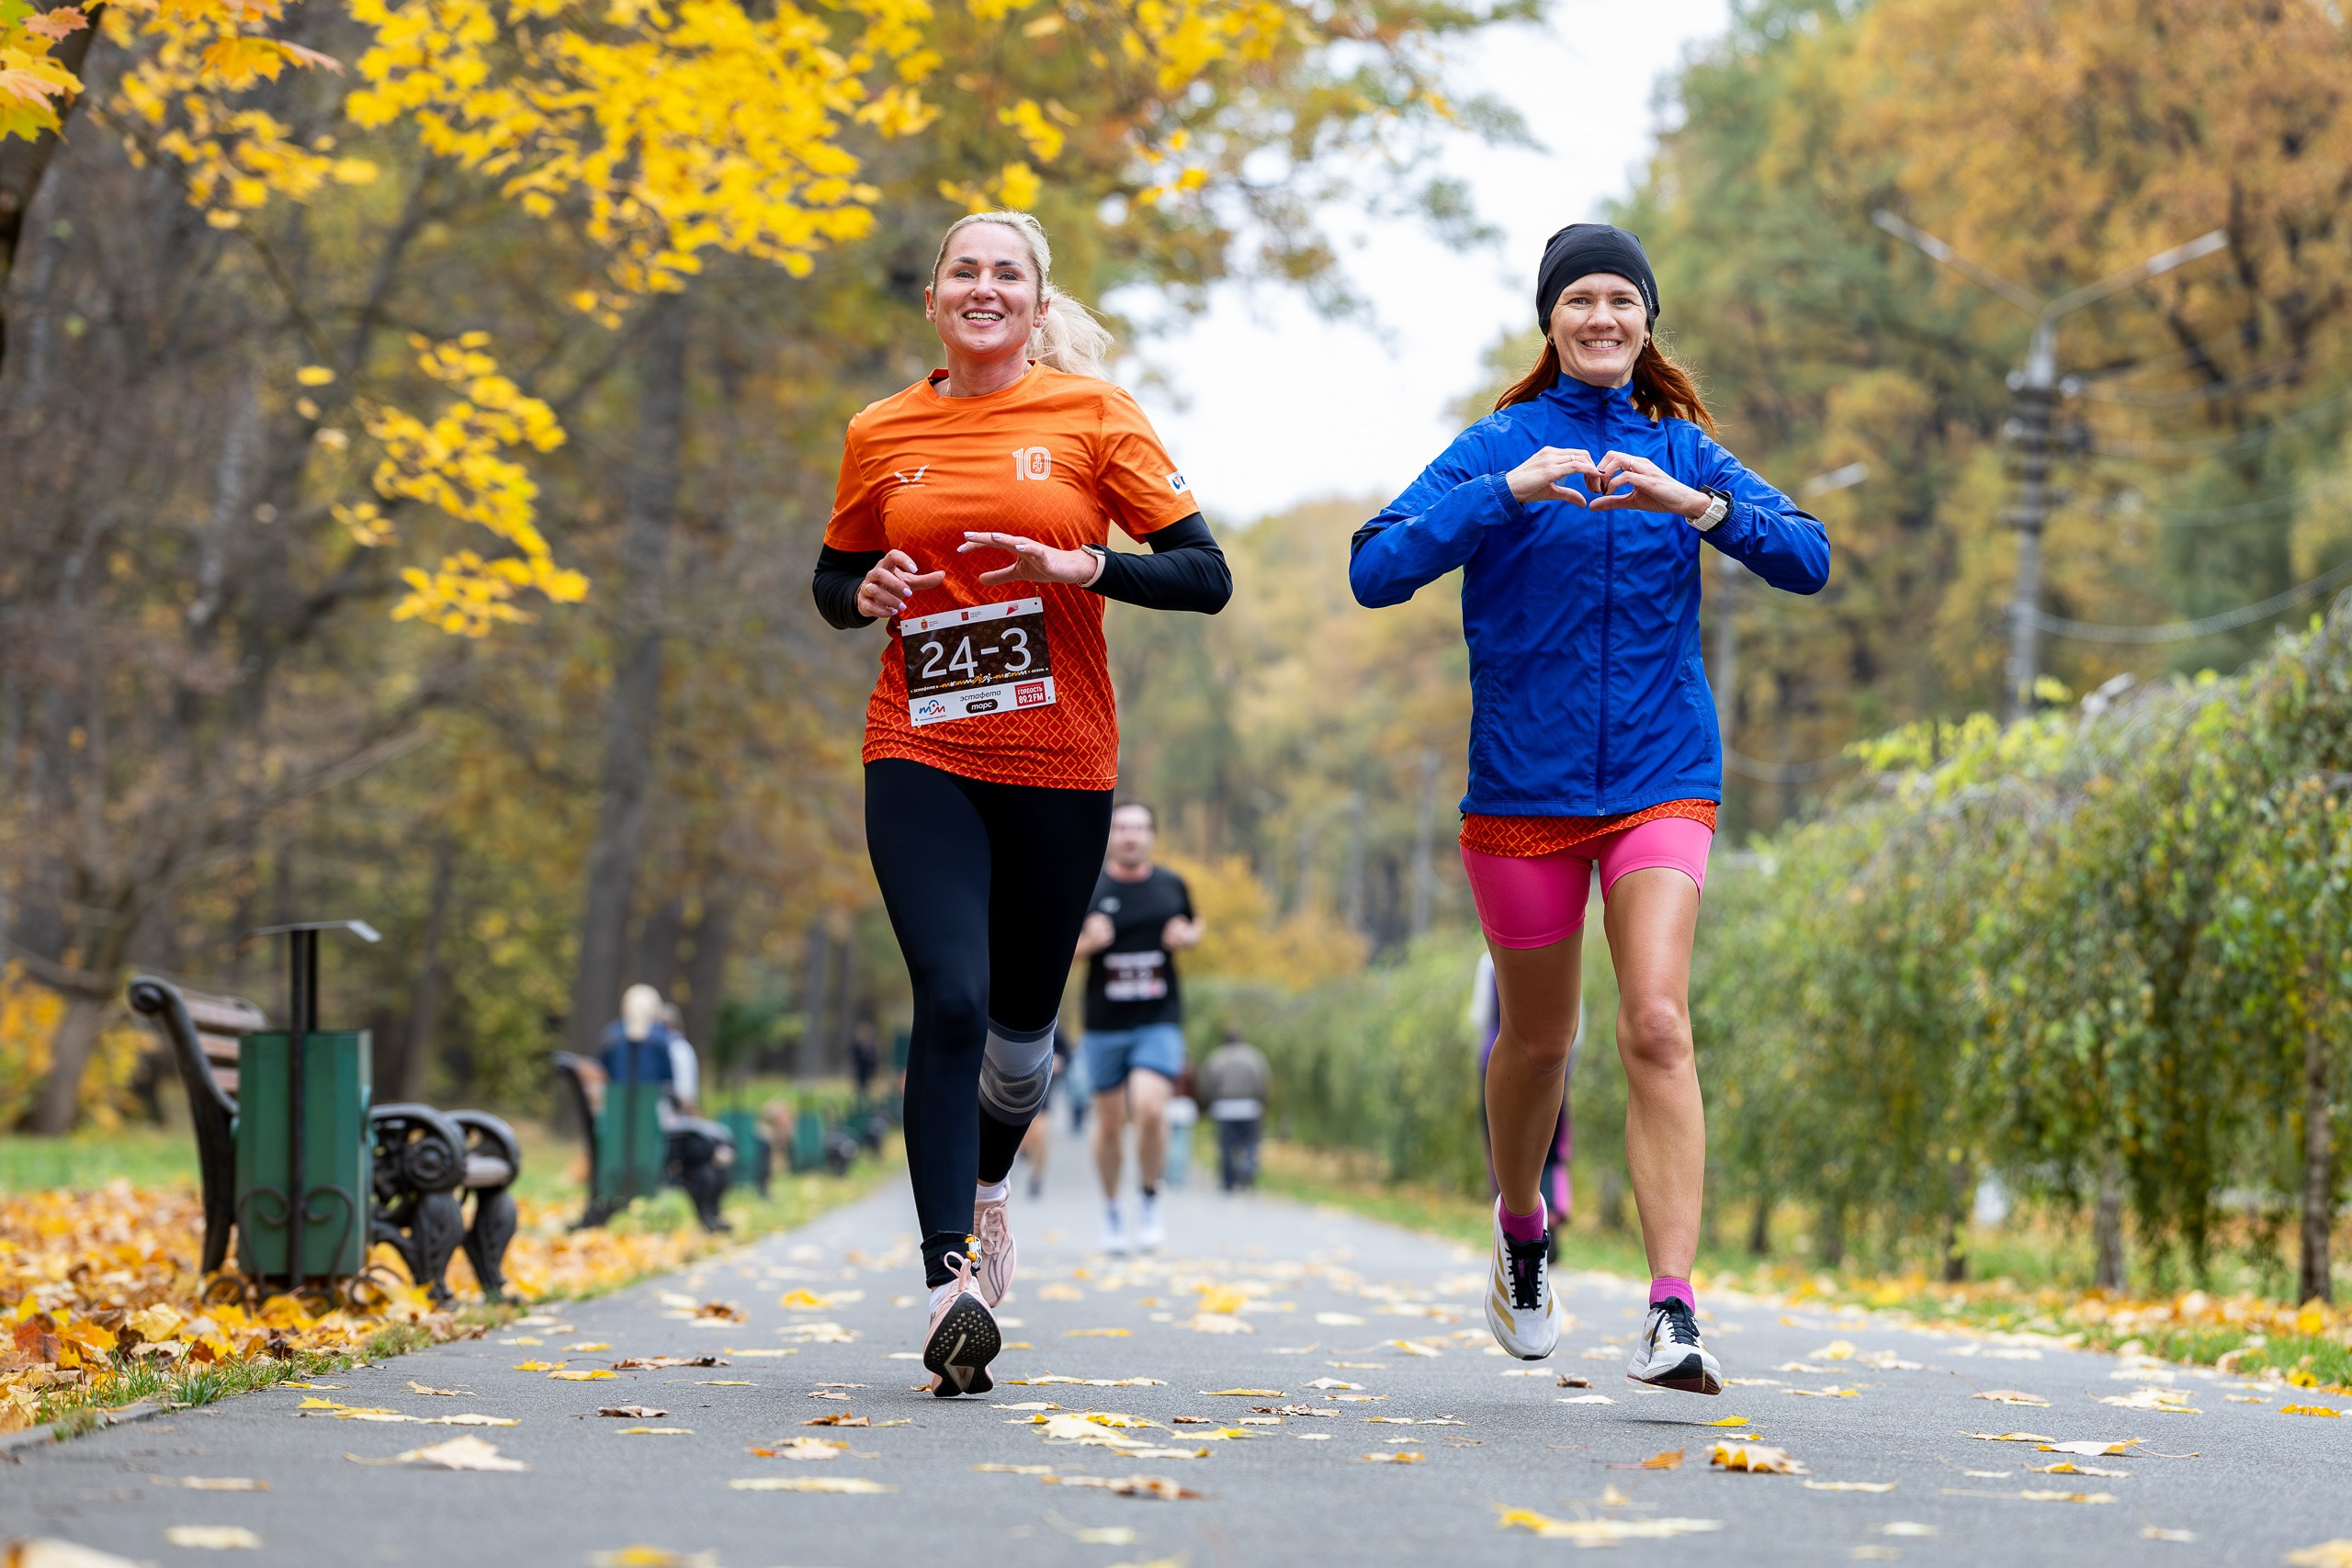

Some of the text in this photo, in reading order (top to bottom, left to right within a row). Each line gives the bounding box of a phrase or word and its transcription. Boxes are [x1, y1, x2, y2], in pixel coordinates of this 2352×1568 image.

[1011, 446, 1052, 481] 10
[920, 627, 1032, 679] 24-3
[959, 690, 1001, 702] эстафета
[1017, 686, 1043, 695] ГОРДОСТЬ
[1018, 693, 1044, 705] 89.2 FM
